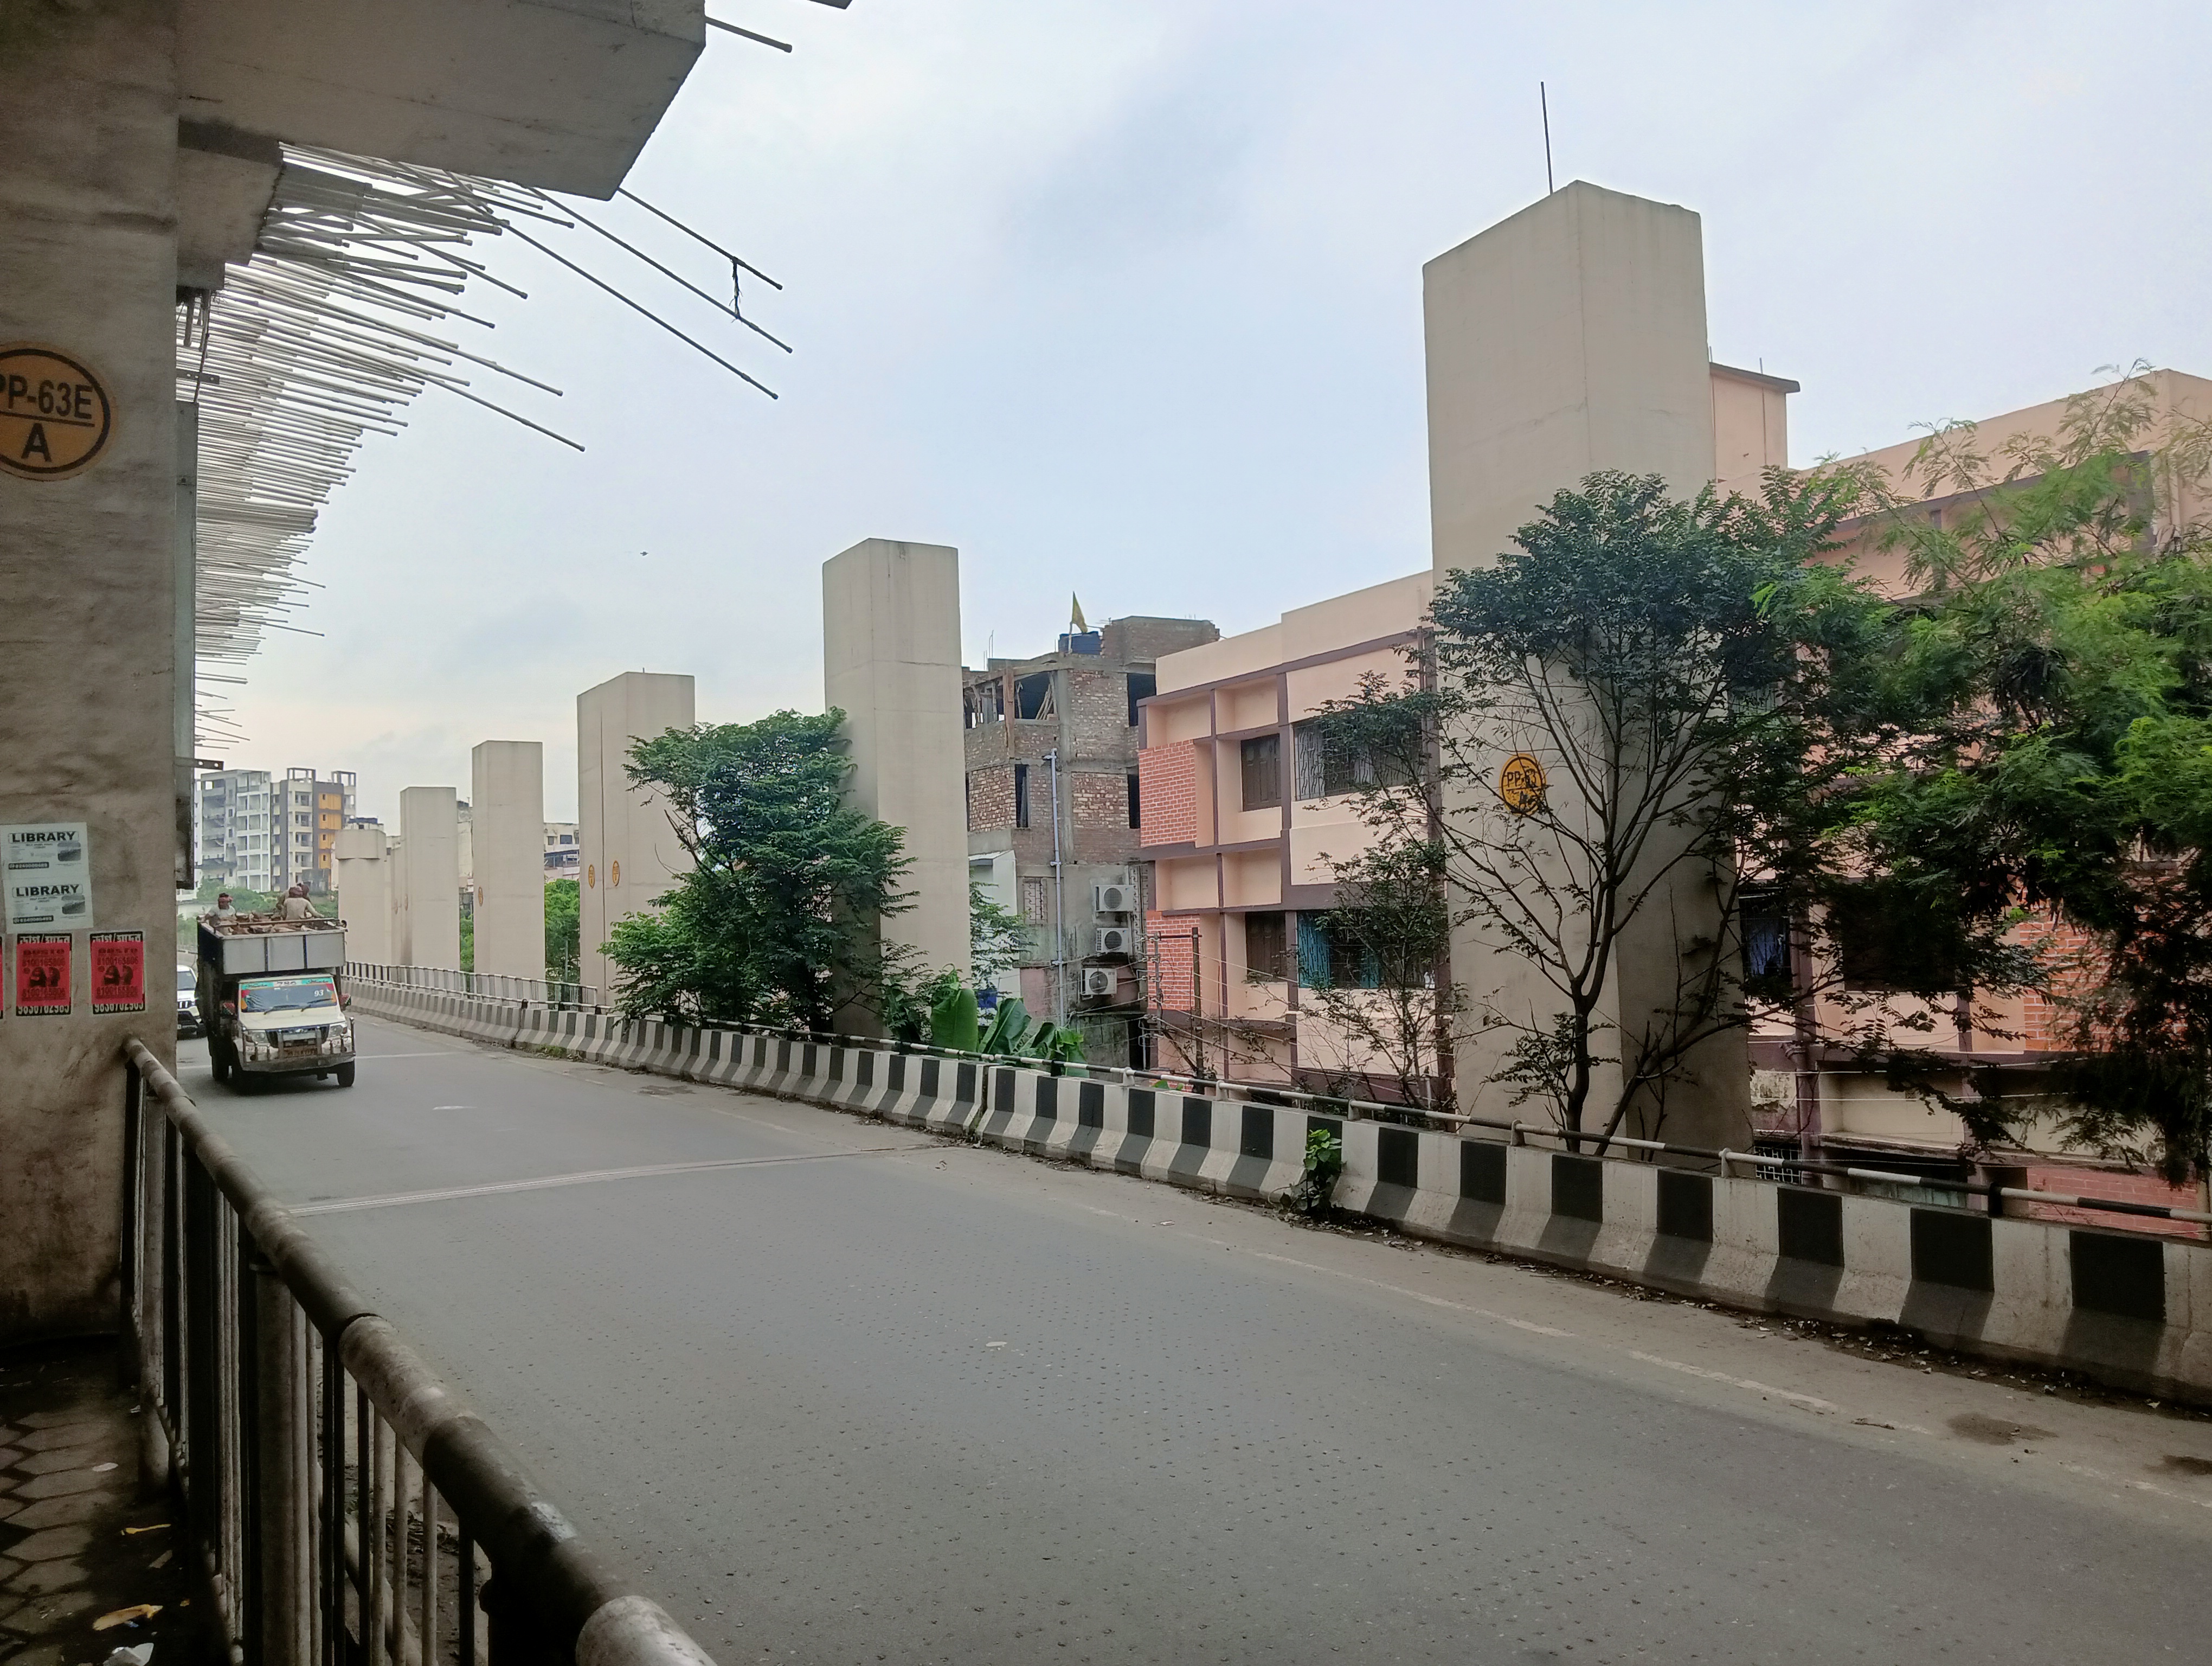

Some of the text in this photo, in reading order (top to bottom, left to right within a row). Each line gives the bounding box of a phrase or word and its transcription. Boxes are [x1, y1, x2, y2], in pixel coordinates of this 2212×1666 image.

[0, 374, 93, 420] P-63E
[21, 422, 52, 462] A
[12, 831, 76, 843] LIBRARY
[16, 884, 80, 896] LIBRARY
